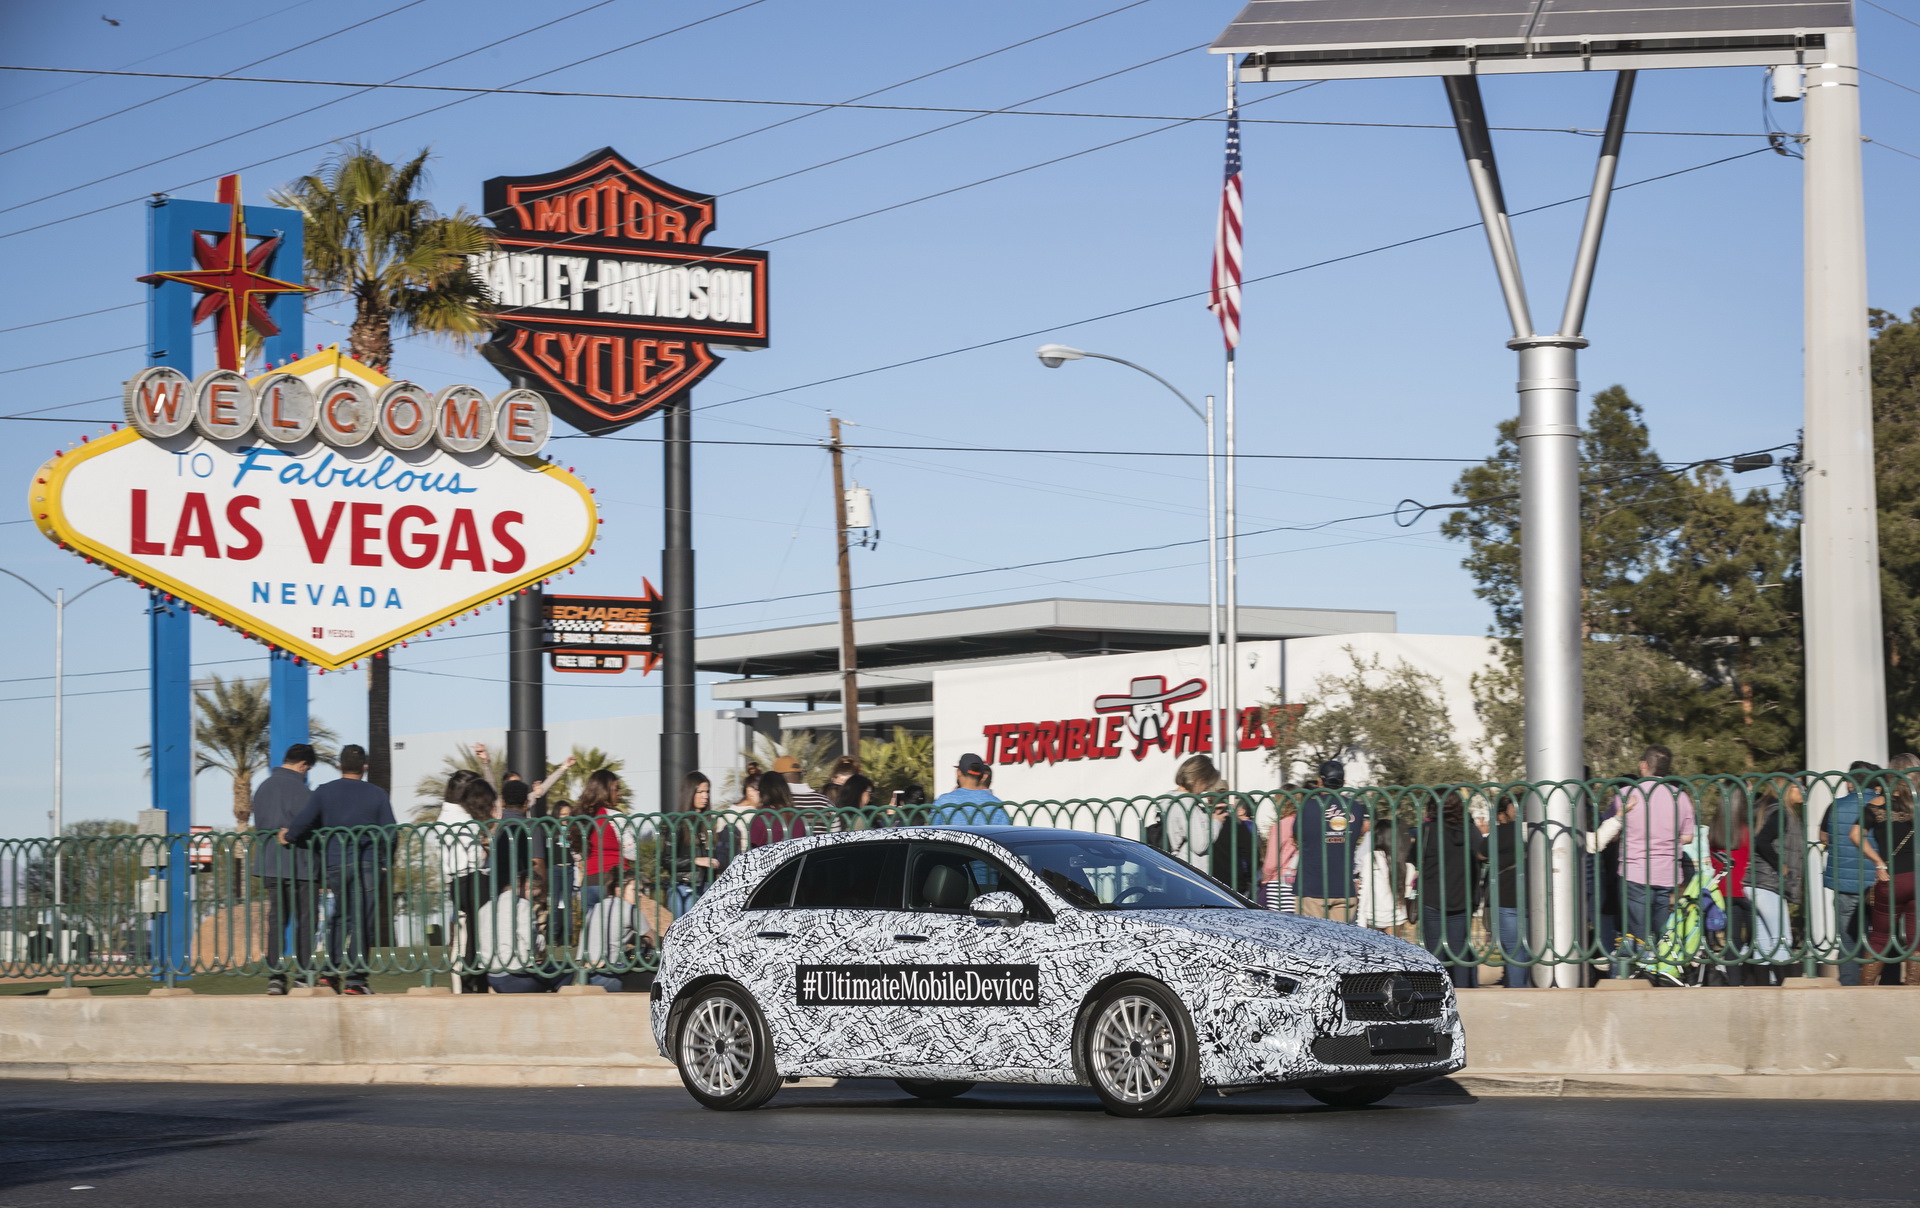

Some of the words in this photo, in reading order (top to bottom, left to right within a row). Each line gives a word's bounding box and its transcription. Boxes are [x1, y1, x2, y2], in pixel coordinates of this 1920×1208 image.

[533, 173, 688, 244] MOTOR
[533, 332, 686, 405] CYCLES
[140, 381, 535, 443] WELCOME
[171, 451, 214, 478] TO
[234, 446, 478, 494] Fabulous
[130, 488, 263, 561] LAS
[291, 498, 527, 575] VEGAS
[251, 582, 403, 610] NEVADA
[606, 622, 648, 633] ZONE
[983, 715, 1125, 767] TERRIBLE
[802, 971, 1035, 1001] #UltimateMobileDevice
